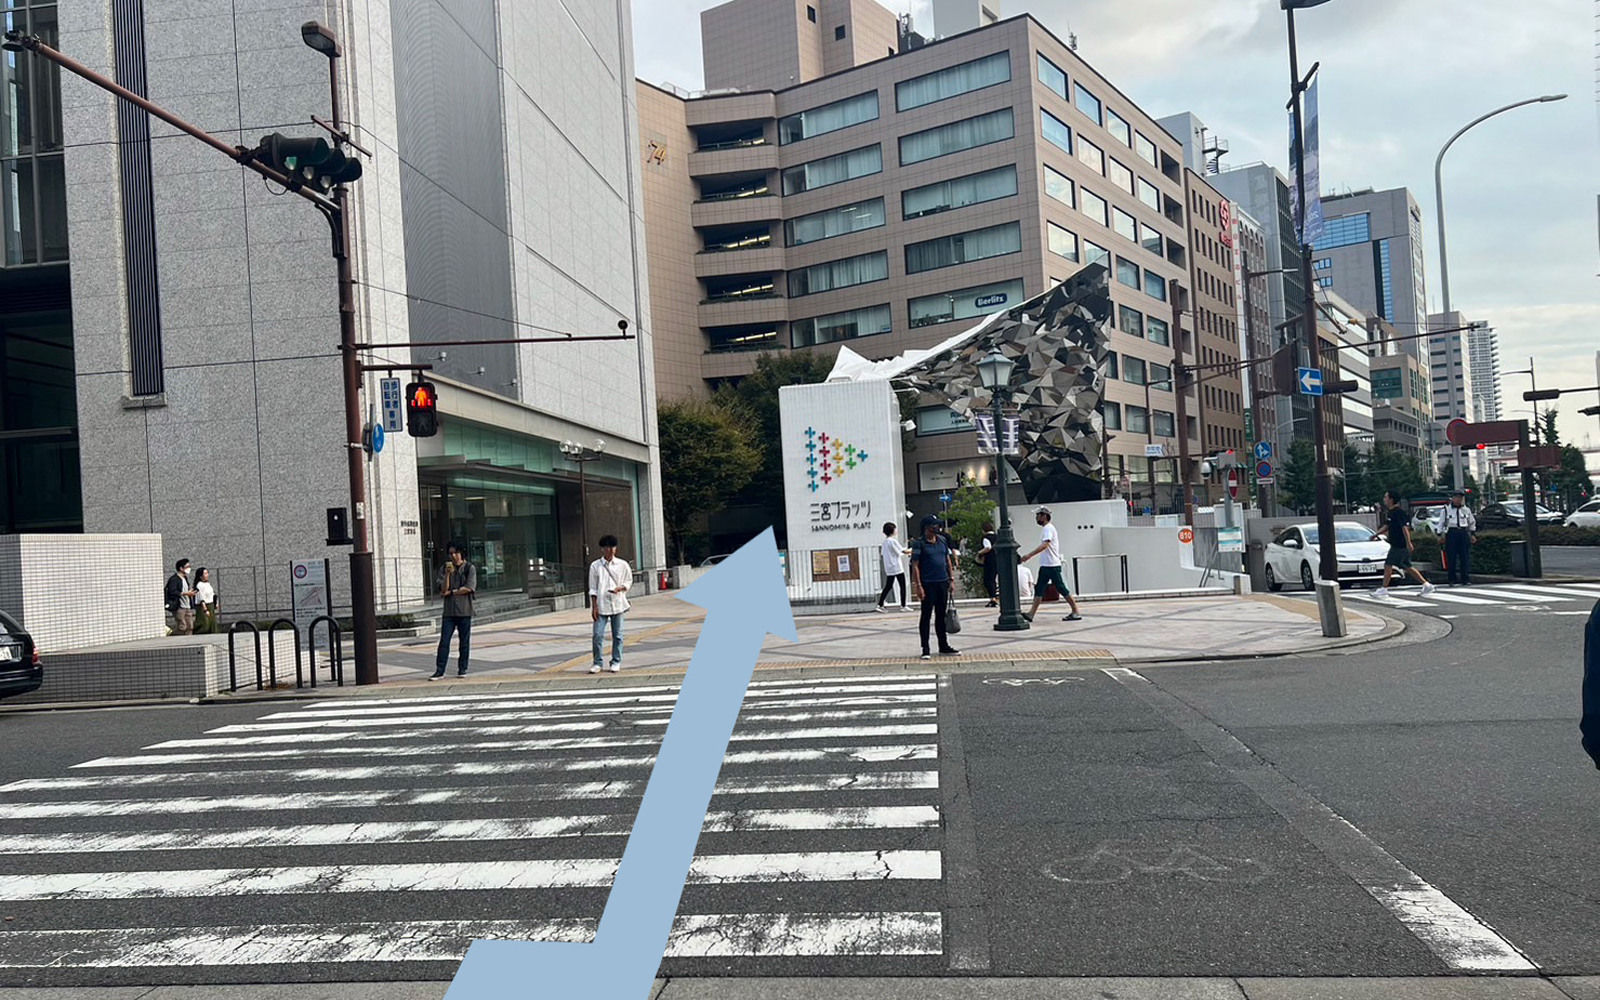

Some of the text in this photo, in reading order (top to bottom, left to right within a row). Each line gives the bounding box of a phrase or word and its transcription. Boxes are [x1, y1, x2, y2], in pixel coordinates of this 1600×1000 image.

[977, 295, 1004, 306] Berlitz
[810, 500, 871, 522] 三宮プラッツ
[811, 522, 871, 532] SANNOMIYA PLATZ
